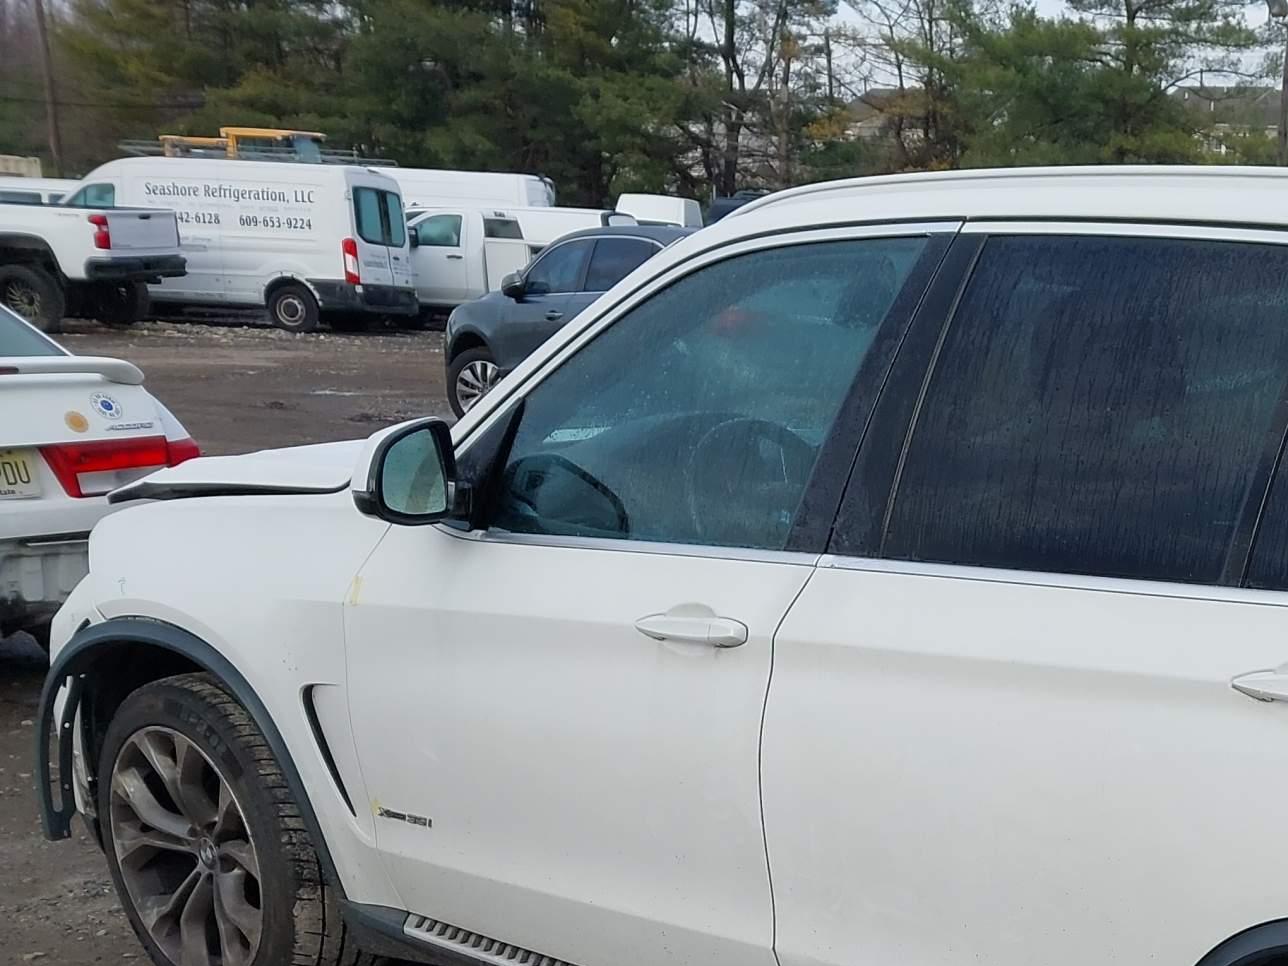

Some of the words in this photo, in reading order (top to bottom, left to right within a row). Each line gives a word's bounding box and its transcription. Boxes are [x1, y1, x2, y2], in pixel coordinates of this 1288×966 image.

[145, 182, 199, 197] Seashore
[203, 184, 290, 204] Refrigeration,
[294, 190, 315, 203] LLC
[239, 214, 312, 230] 609-653-9224
